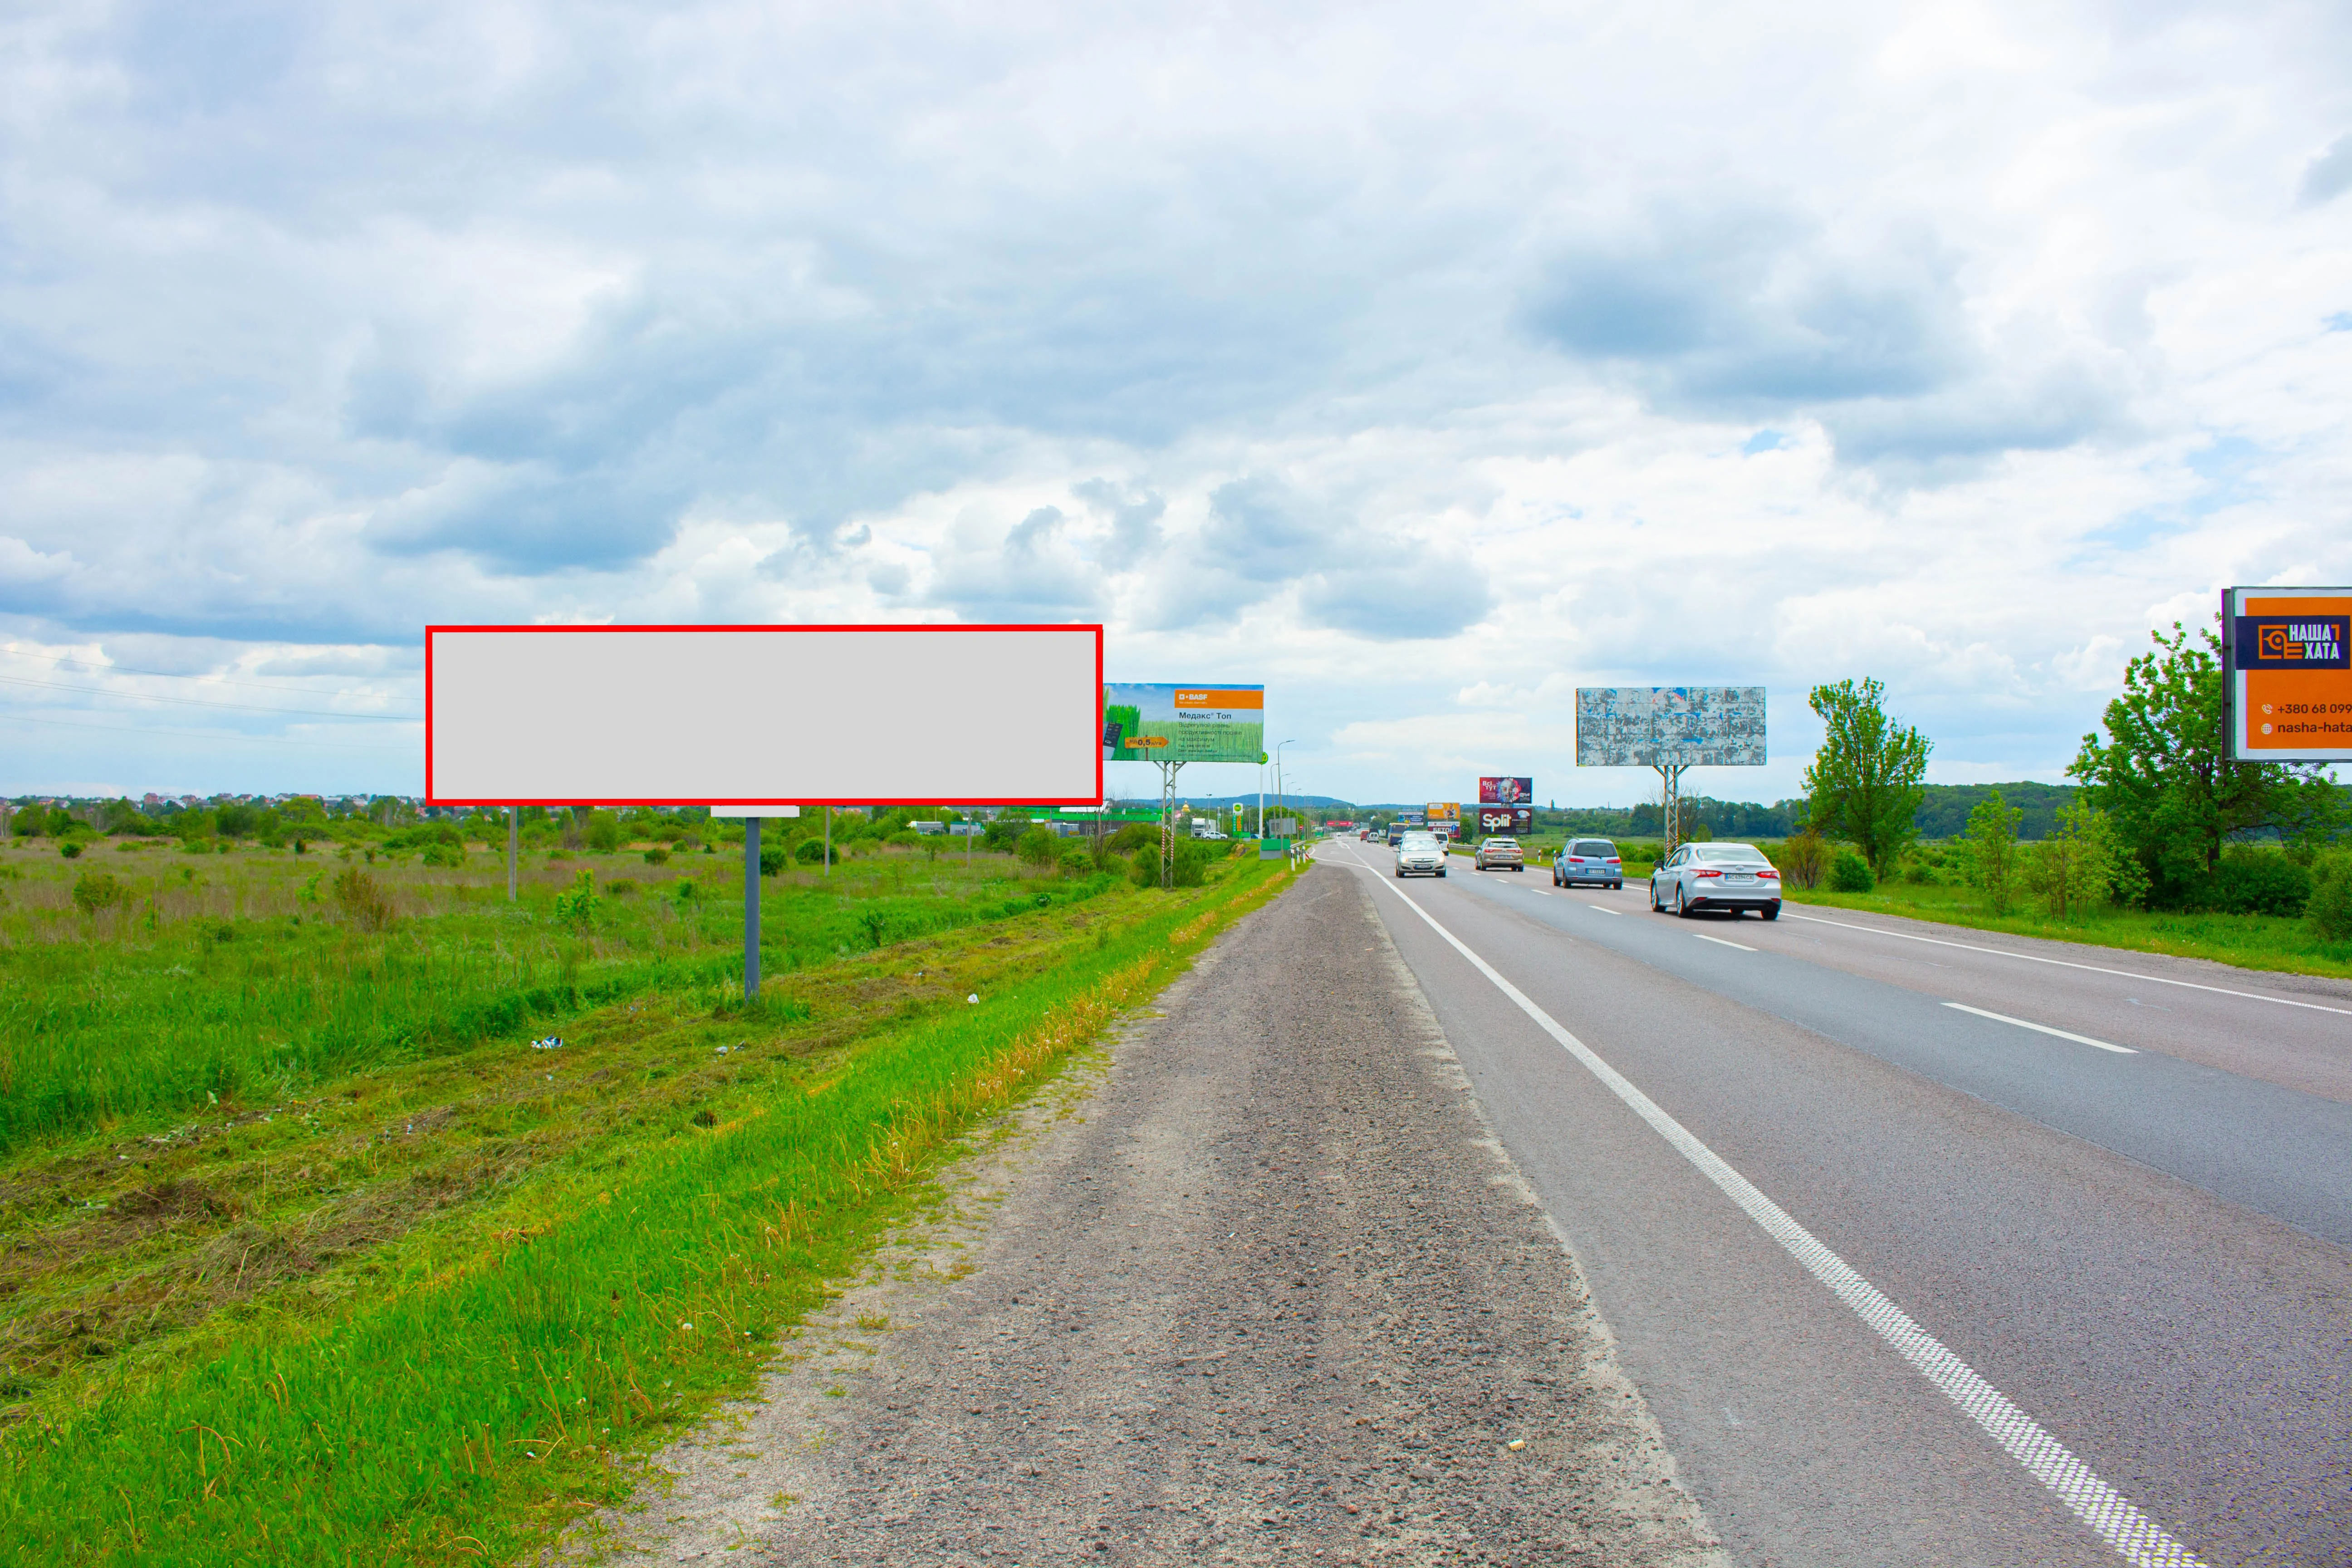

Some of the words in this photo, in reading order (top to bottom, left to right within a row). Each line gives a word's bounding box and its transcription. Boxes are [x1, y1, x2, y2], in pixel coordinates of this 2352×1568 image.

[2289, 624, 2332, 641] НАША
[2304, 642, 2340, 659] ХАТА
[2278, 704, 2308, 714] +380
[2312, 704, 2327, 714] 68
[2330, 704, 2352, 714] 099
[1482, 813, 1512, 832] Split
